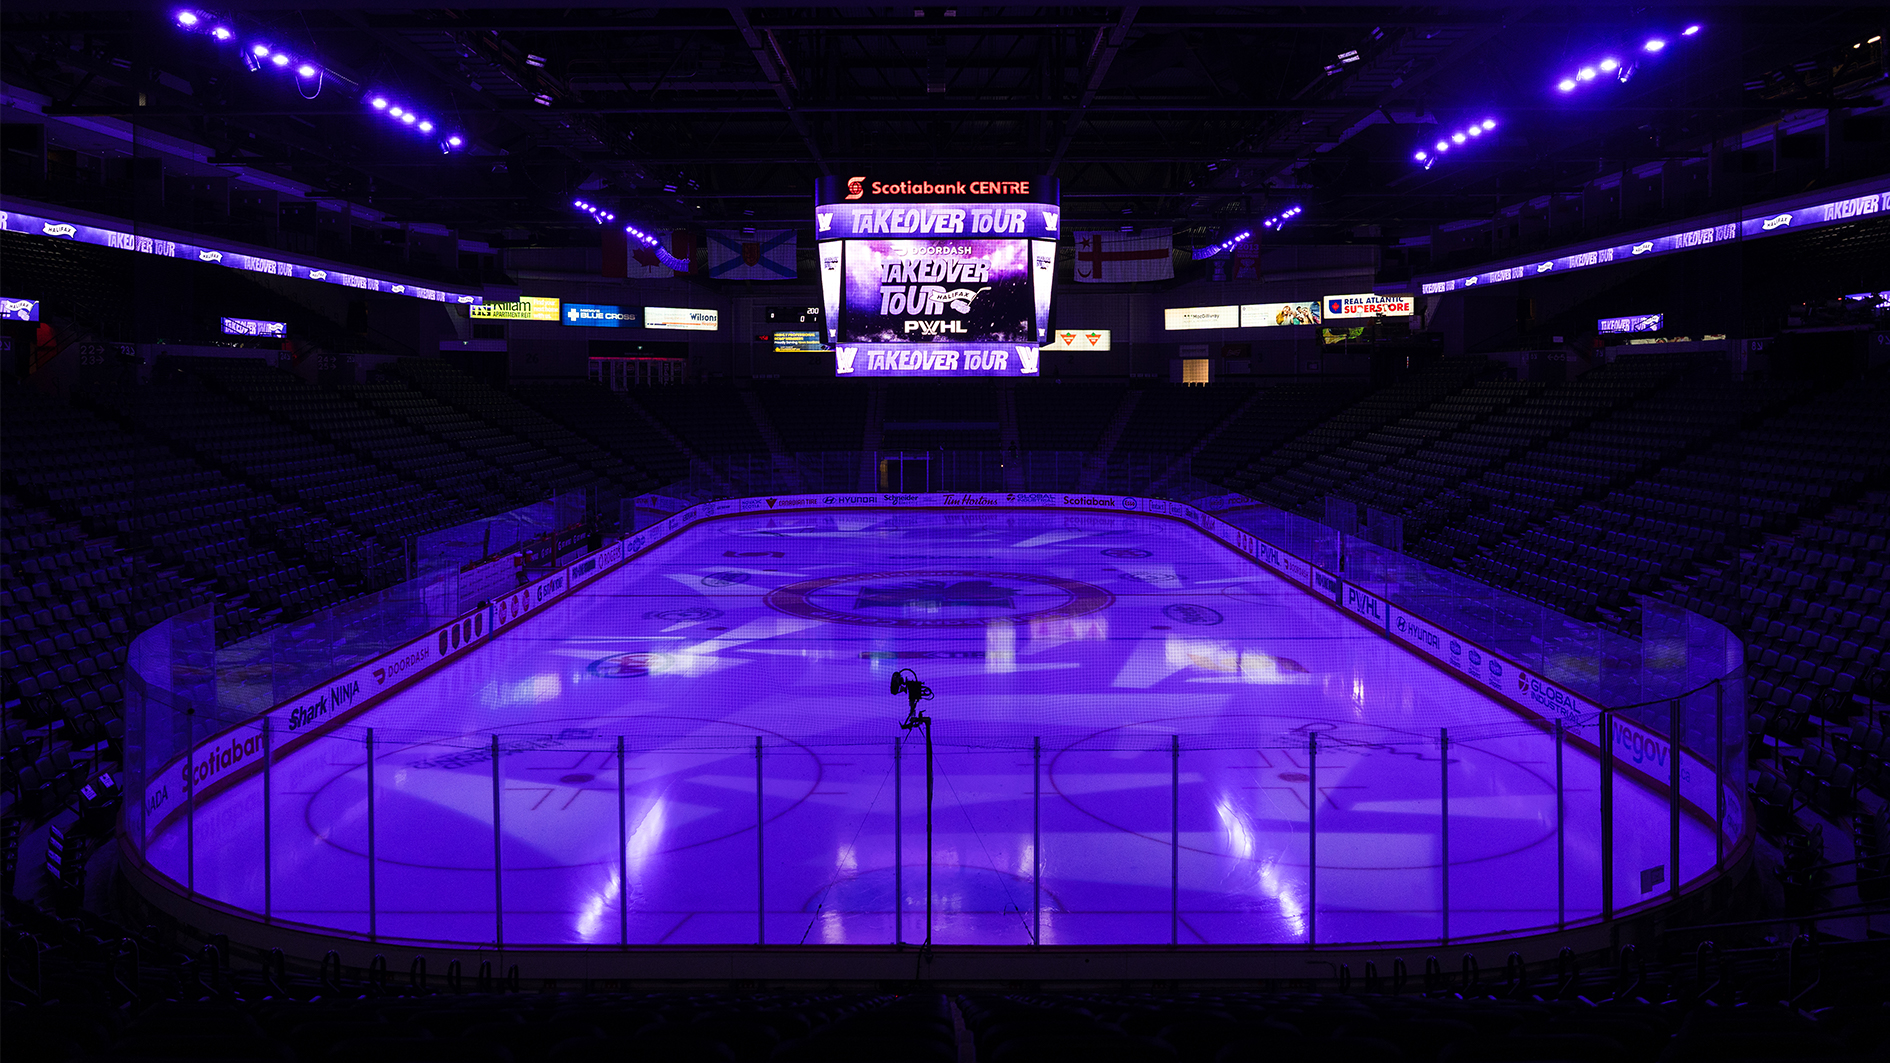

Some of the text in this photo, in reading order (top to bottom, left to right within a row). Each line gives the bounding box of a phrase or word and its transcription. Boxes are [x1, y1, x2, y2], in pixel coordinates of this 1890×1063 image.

[871, 181, 1030, 195] Scotiabank CENTRE
[851, 208, 1027, 233] TAKEOVER TOUR
[1824, 194, 1879, 222] TAKEOVER
[107, 230, 175, 258] TAKEOVER TOUR
[1675, 222, 1736, 249] TAKEOVER TOUR
[912, 246, 972, 255] DOORDASH
[881, 258, 991, 283] TAKEOVER
[936, 291, 970, 300] HALIFAX
[580, 311, 604, 319] BLUE
[690, 312, 717, 322] Wilsons
[904, 320, 968, 335] PWHL
[867, 350, 1008, 371] TAKEOVER TOUR
[838, 496, 878, 504] HYUNDAI
[943, 494, 998, 506] Tim Hortons
[1063, 496, 1115, 506] Scotiabank
[1260, 544, 1280, 565] PWHL
[1349, 587, 1381, 619] PWHL
[1408, 622, 1440, 650] HYUNDAI
[388, 646, 430, 678] DOORDASH
[331, 680, 360, 712] NINJA
[1530, 678, 1581, 714] GLOBAL
[288, 695, 328, 731] Shark
[1612, 720, 1671, 767] wegov
[182, 732, 265, 793] Scotiaban
[145, 784, 168, 817] NADA
